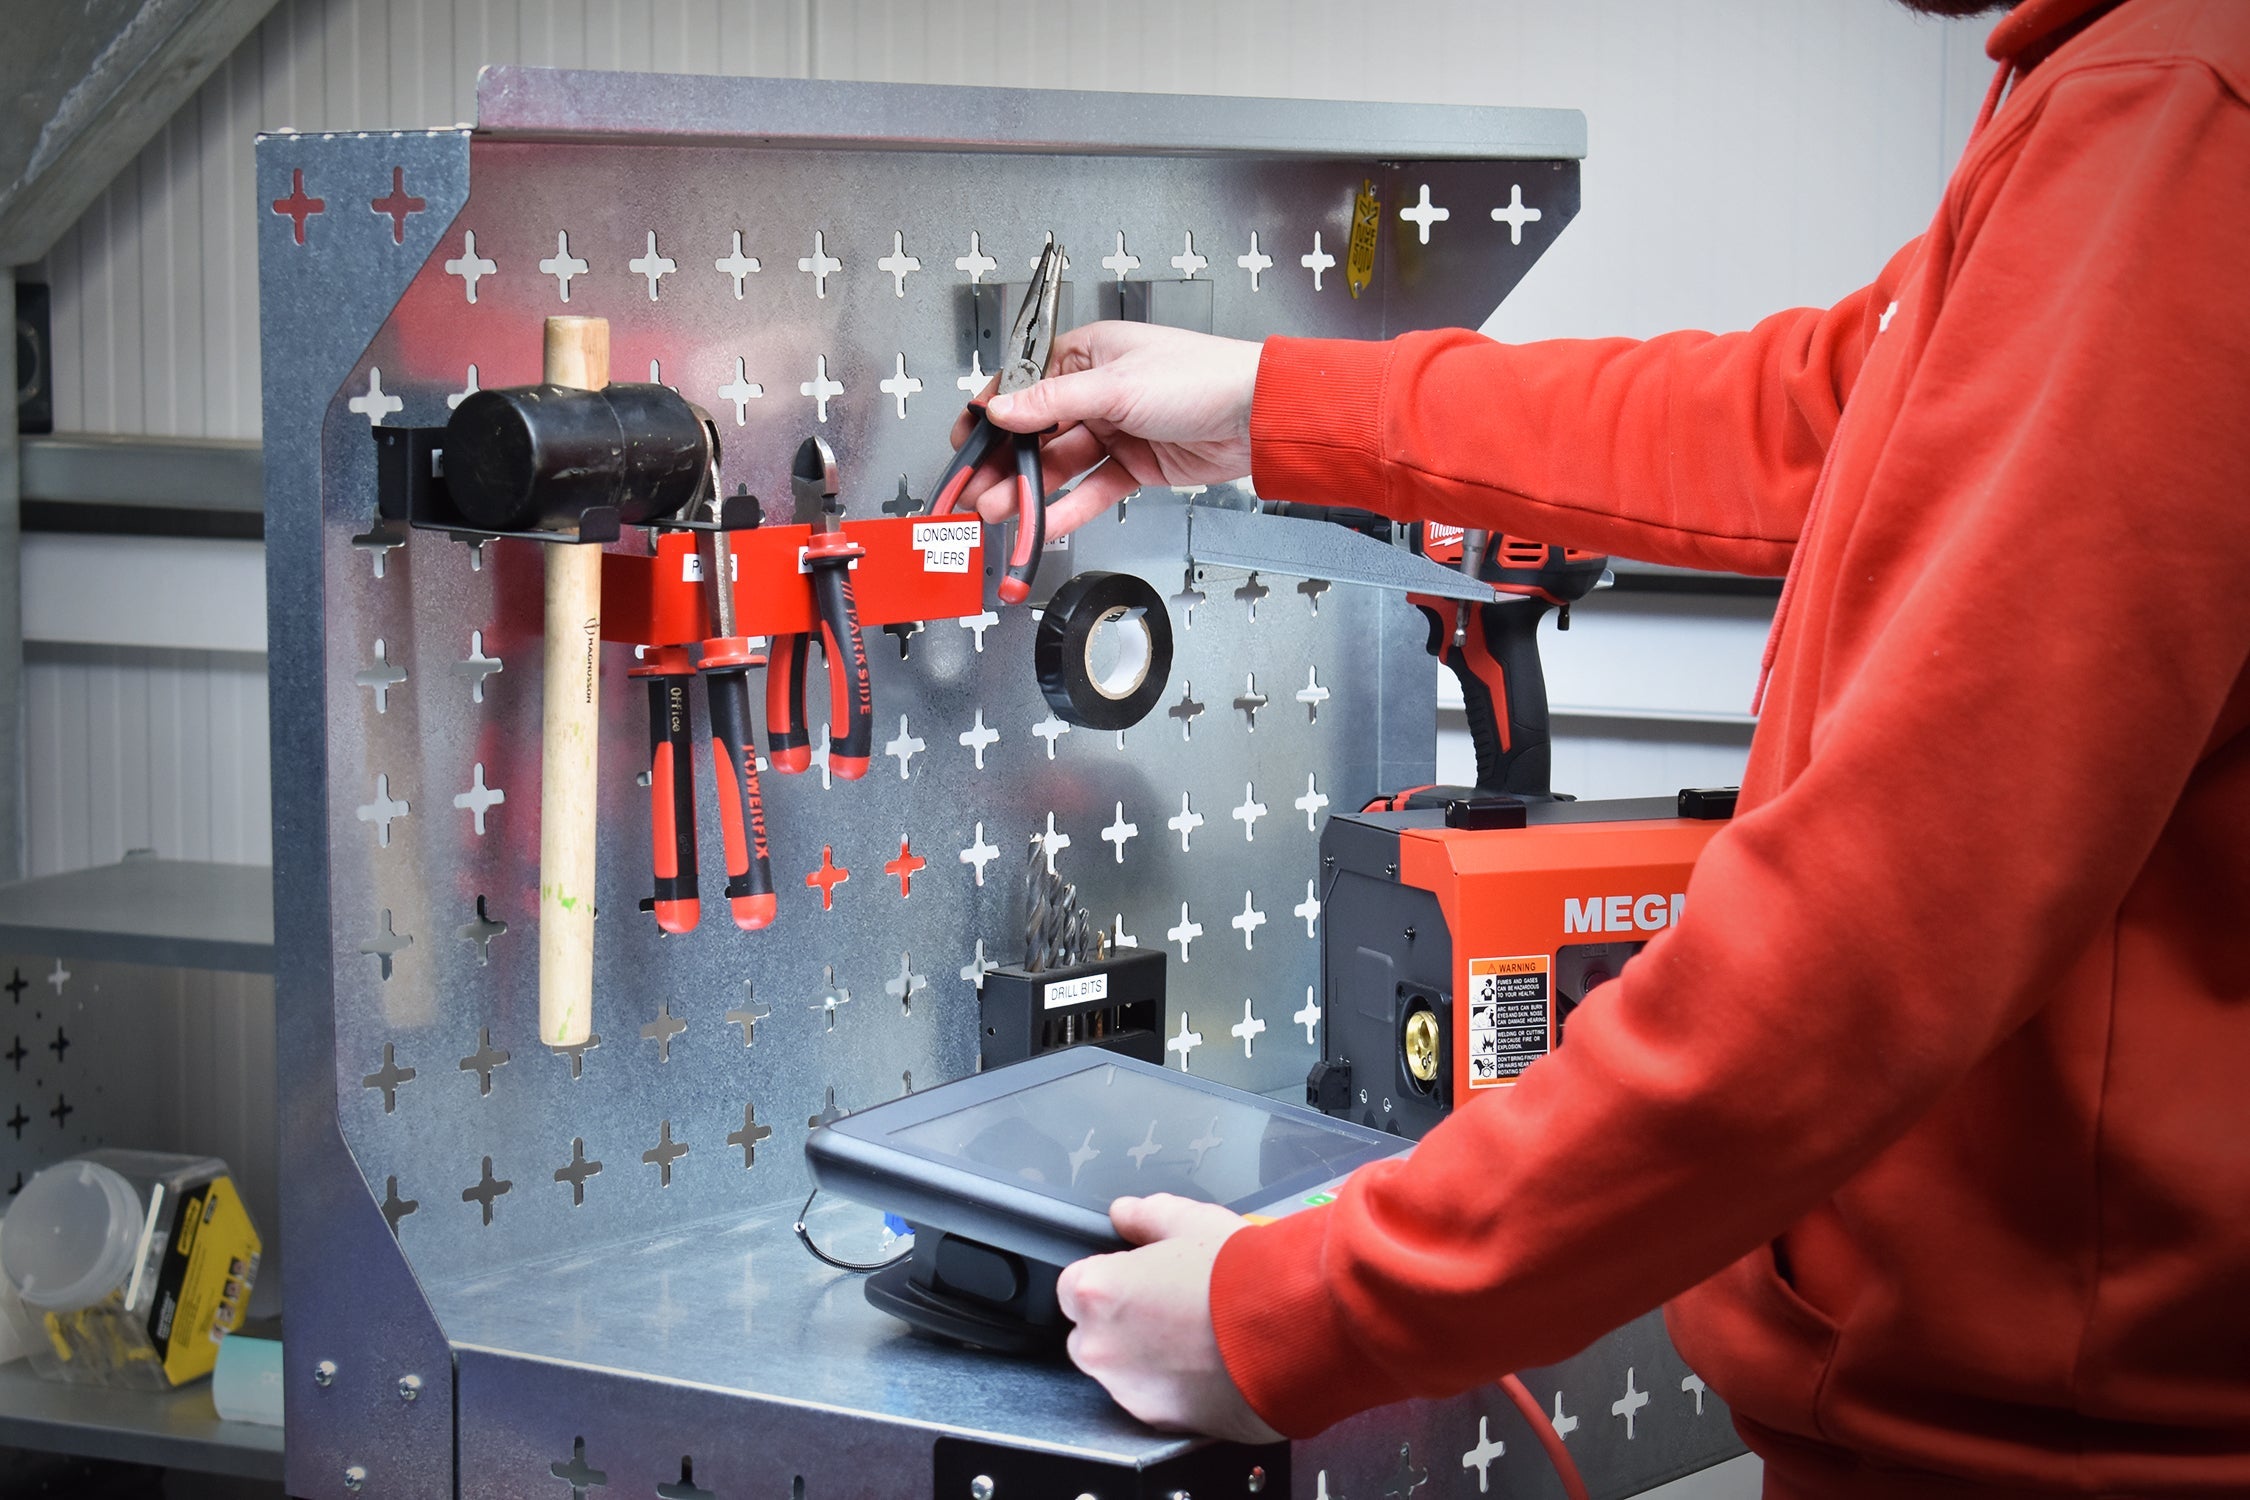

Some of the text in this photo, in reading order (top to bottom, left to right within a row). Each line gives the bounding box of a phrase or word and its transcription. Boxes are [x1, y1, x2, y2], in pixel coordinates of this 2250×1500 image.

[917, 526, 978, 542] LONGNOSE
[926, 551, 965, 565] PLIERS
[586, 638, 594, 703] MAGNUSSON
[846, 609, 872, 715] PARKSIDE
[670, 687, 682, 732] Office
[742, 745, 769, 860] POWERFIX
[1499, 962, 1536, 973] WARNING
[1051, 980, 1102, 1000] DRILL BITS
